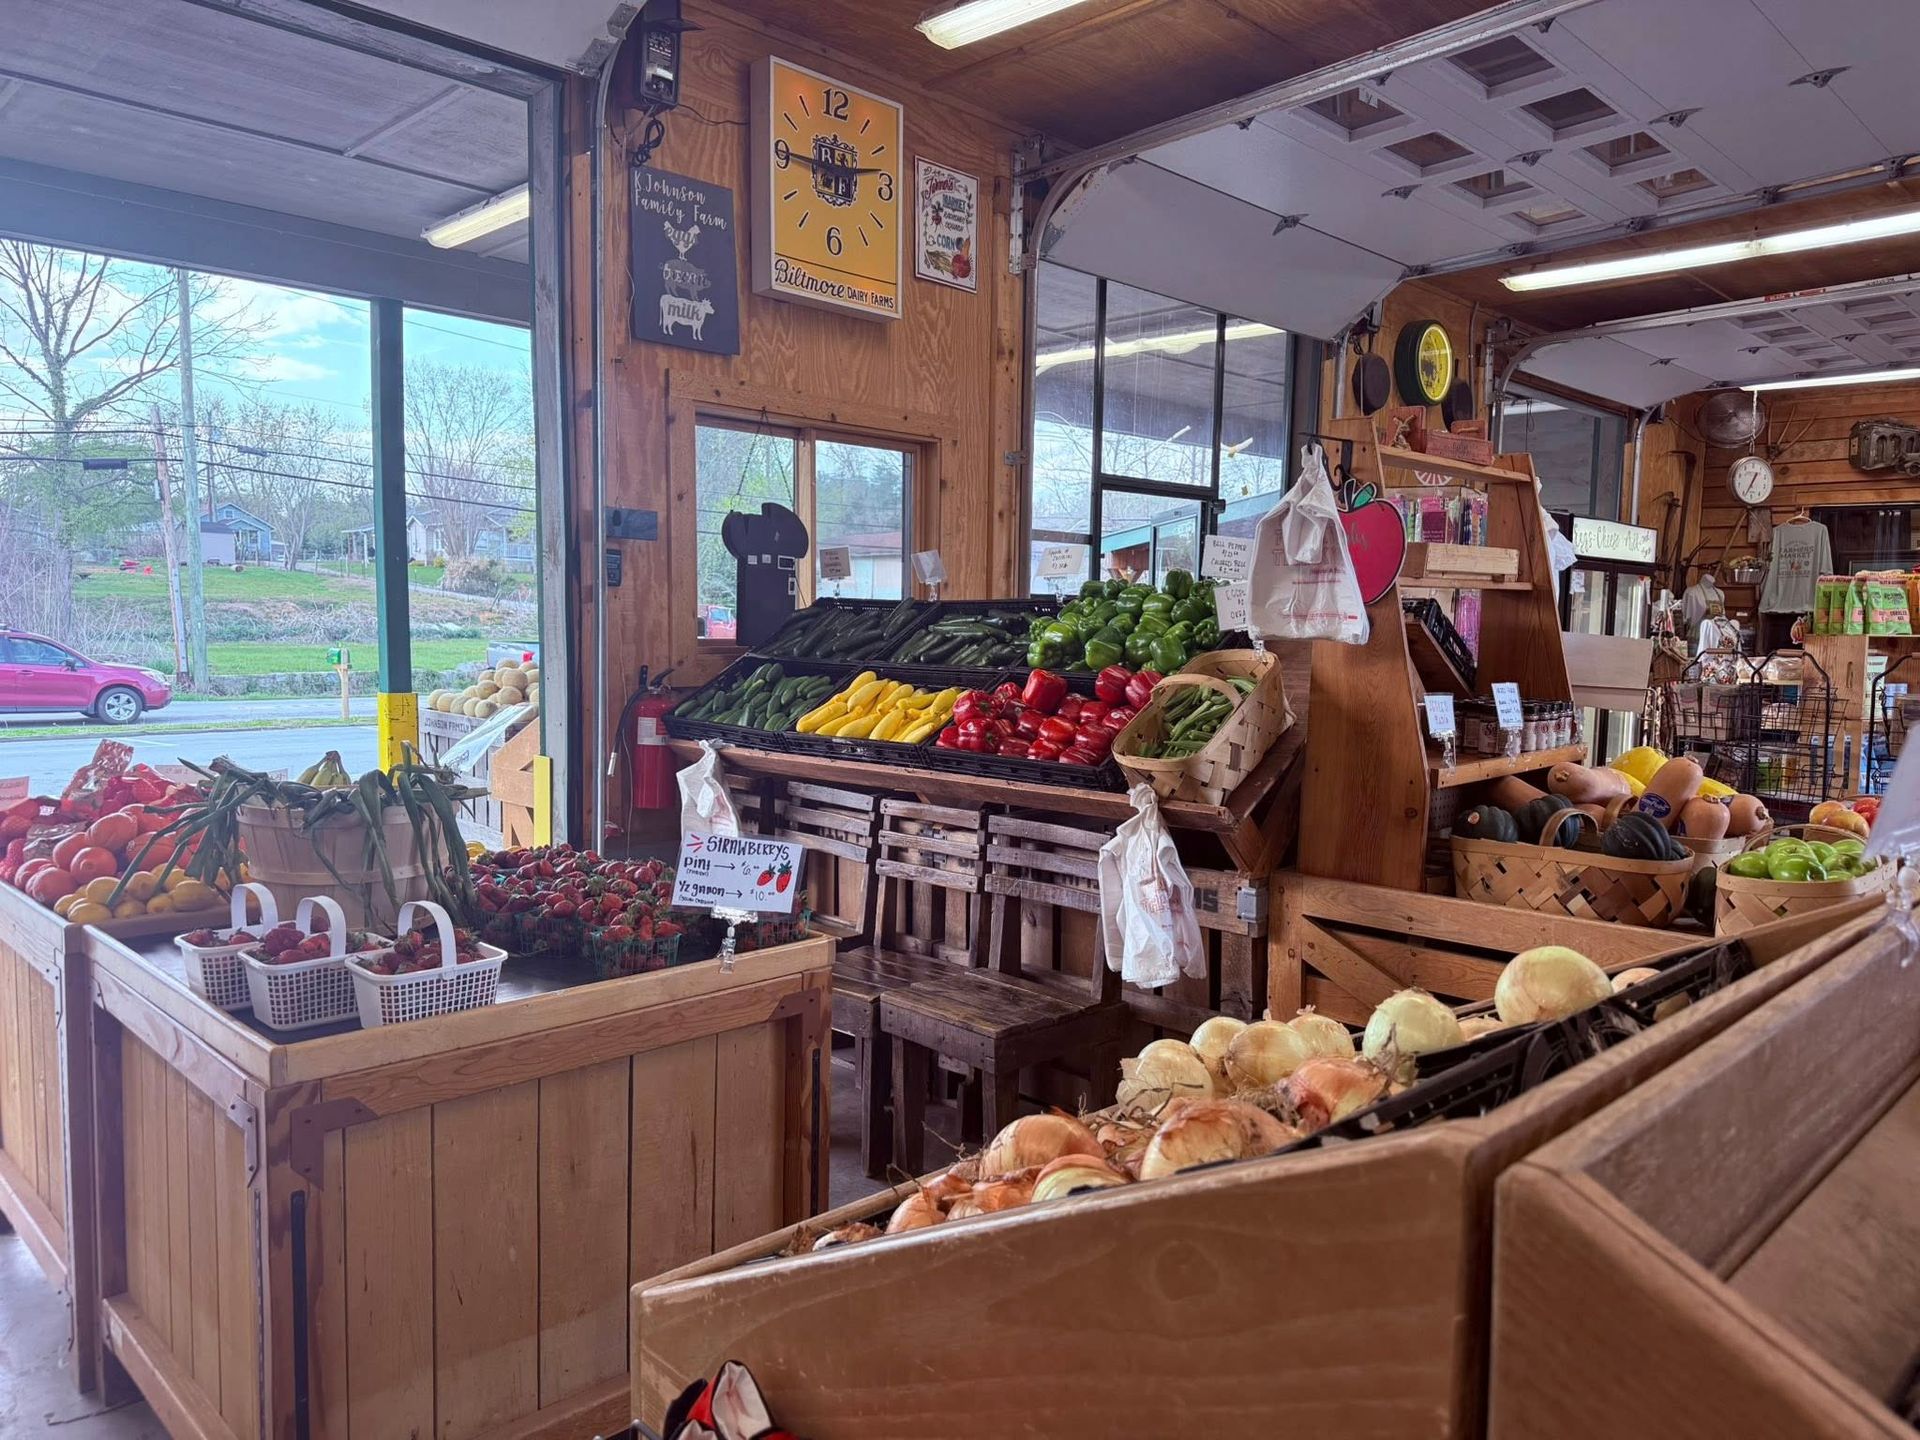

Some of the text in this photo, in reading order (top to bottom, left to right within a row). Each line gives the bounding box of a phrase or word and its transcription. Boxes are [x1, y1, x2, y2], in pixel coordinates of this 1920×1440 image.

[823, 88, 849, 121] 12
[775, 139, 790, 169] 9
[645, 173, 706, 205] Johnson
[878, 172, 893, 202] 3
[635, 188, 727, 230] Family Farm
[826, 226, 842, 256] 6
[936, 233, 956, 251] CORN
[774, 258, 895, 309] Biltmore DAIRY FARMS
[667, 303, 703, 321] milk
[706, 835, 790, 862] STRAWBERRYS
